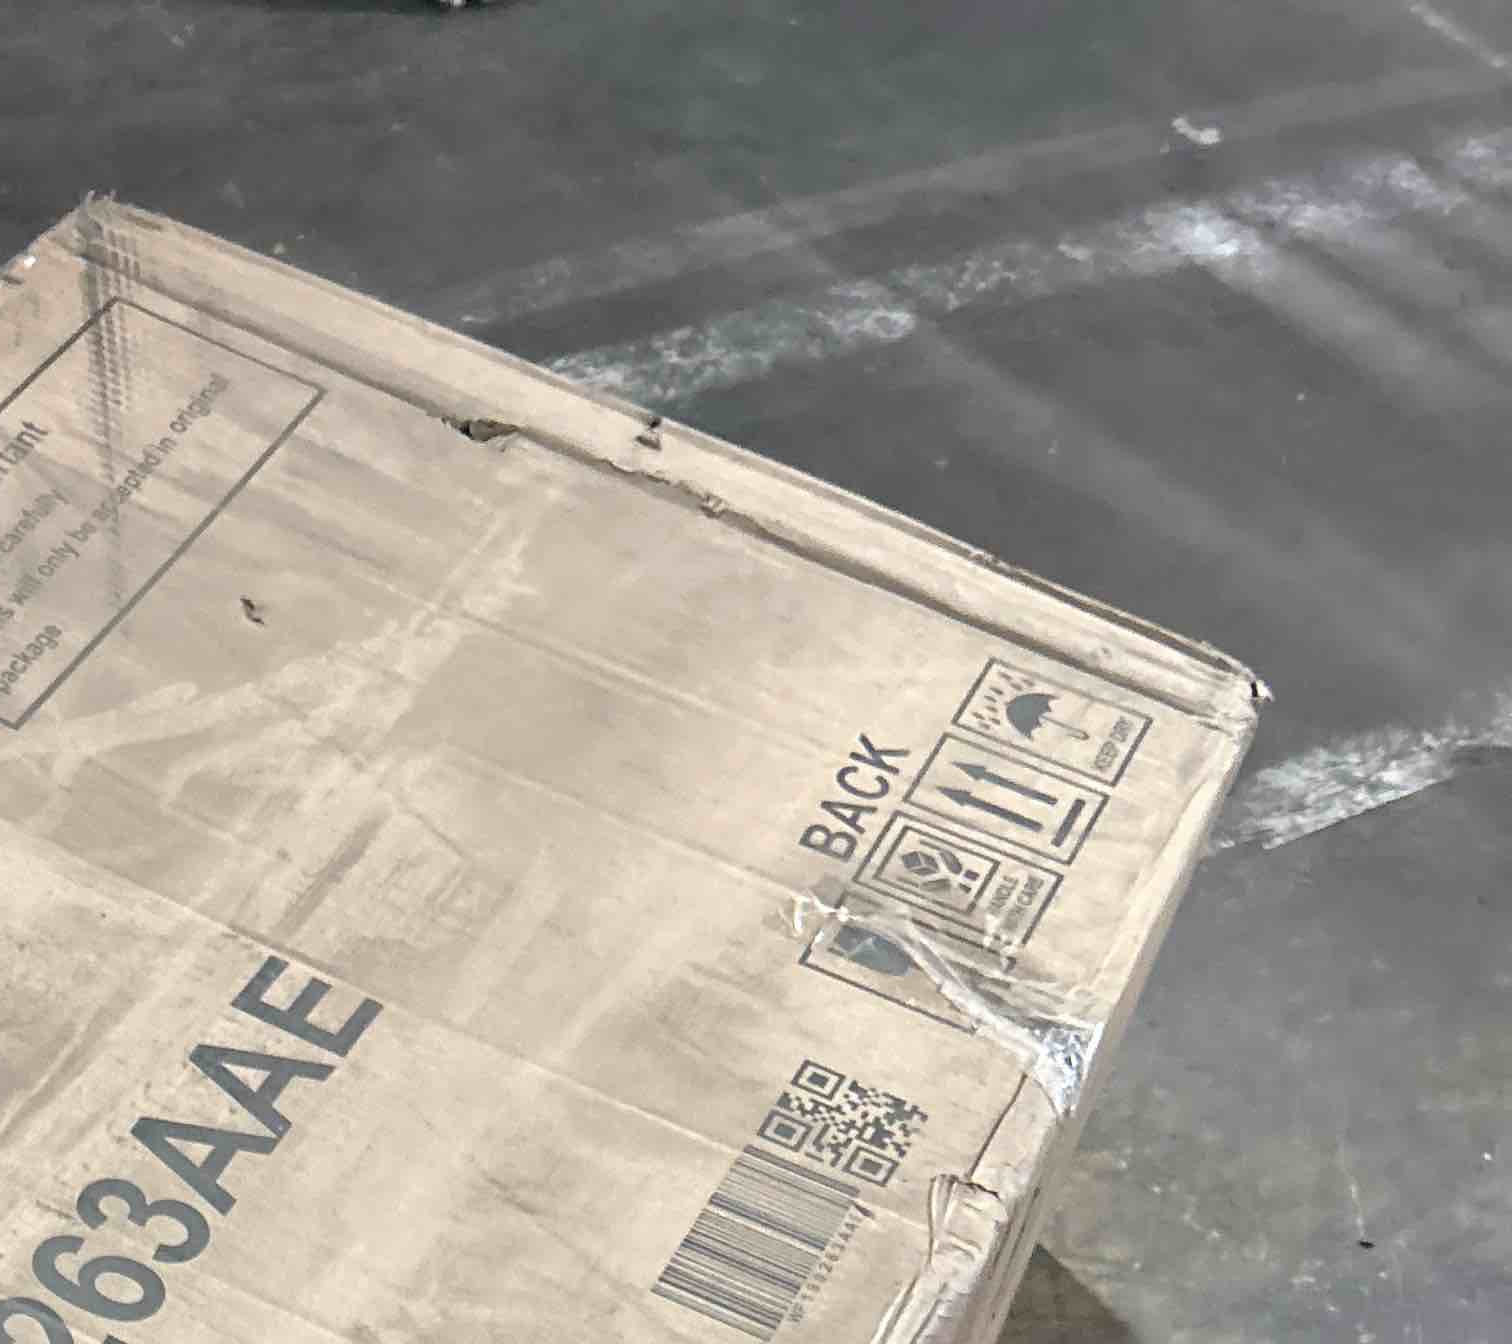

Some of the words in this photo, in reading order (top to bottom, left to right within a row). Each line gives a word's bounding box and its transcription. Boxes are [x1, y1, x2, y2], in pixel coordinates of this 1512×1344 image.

[11, 570, 43, 606] will
[38, 540, 80, 579] only
[69, 519, 95, 543] be
[91, 443, 162, 533] accepted
[155, 435, 179, 456] in
[168, 372, 231, 434] original
[799, 732, 911, 863] BACK
